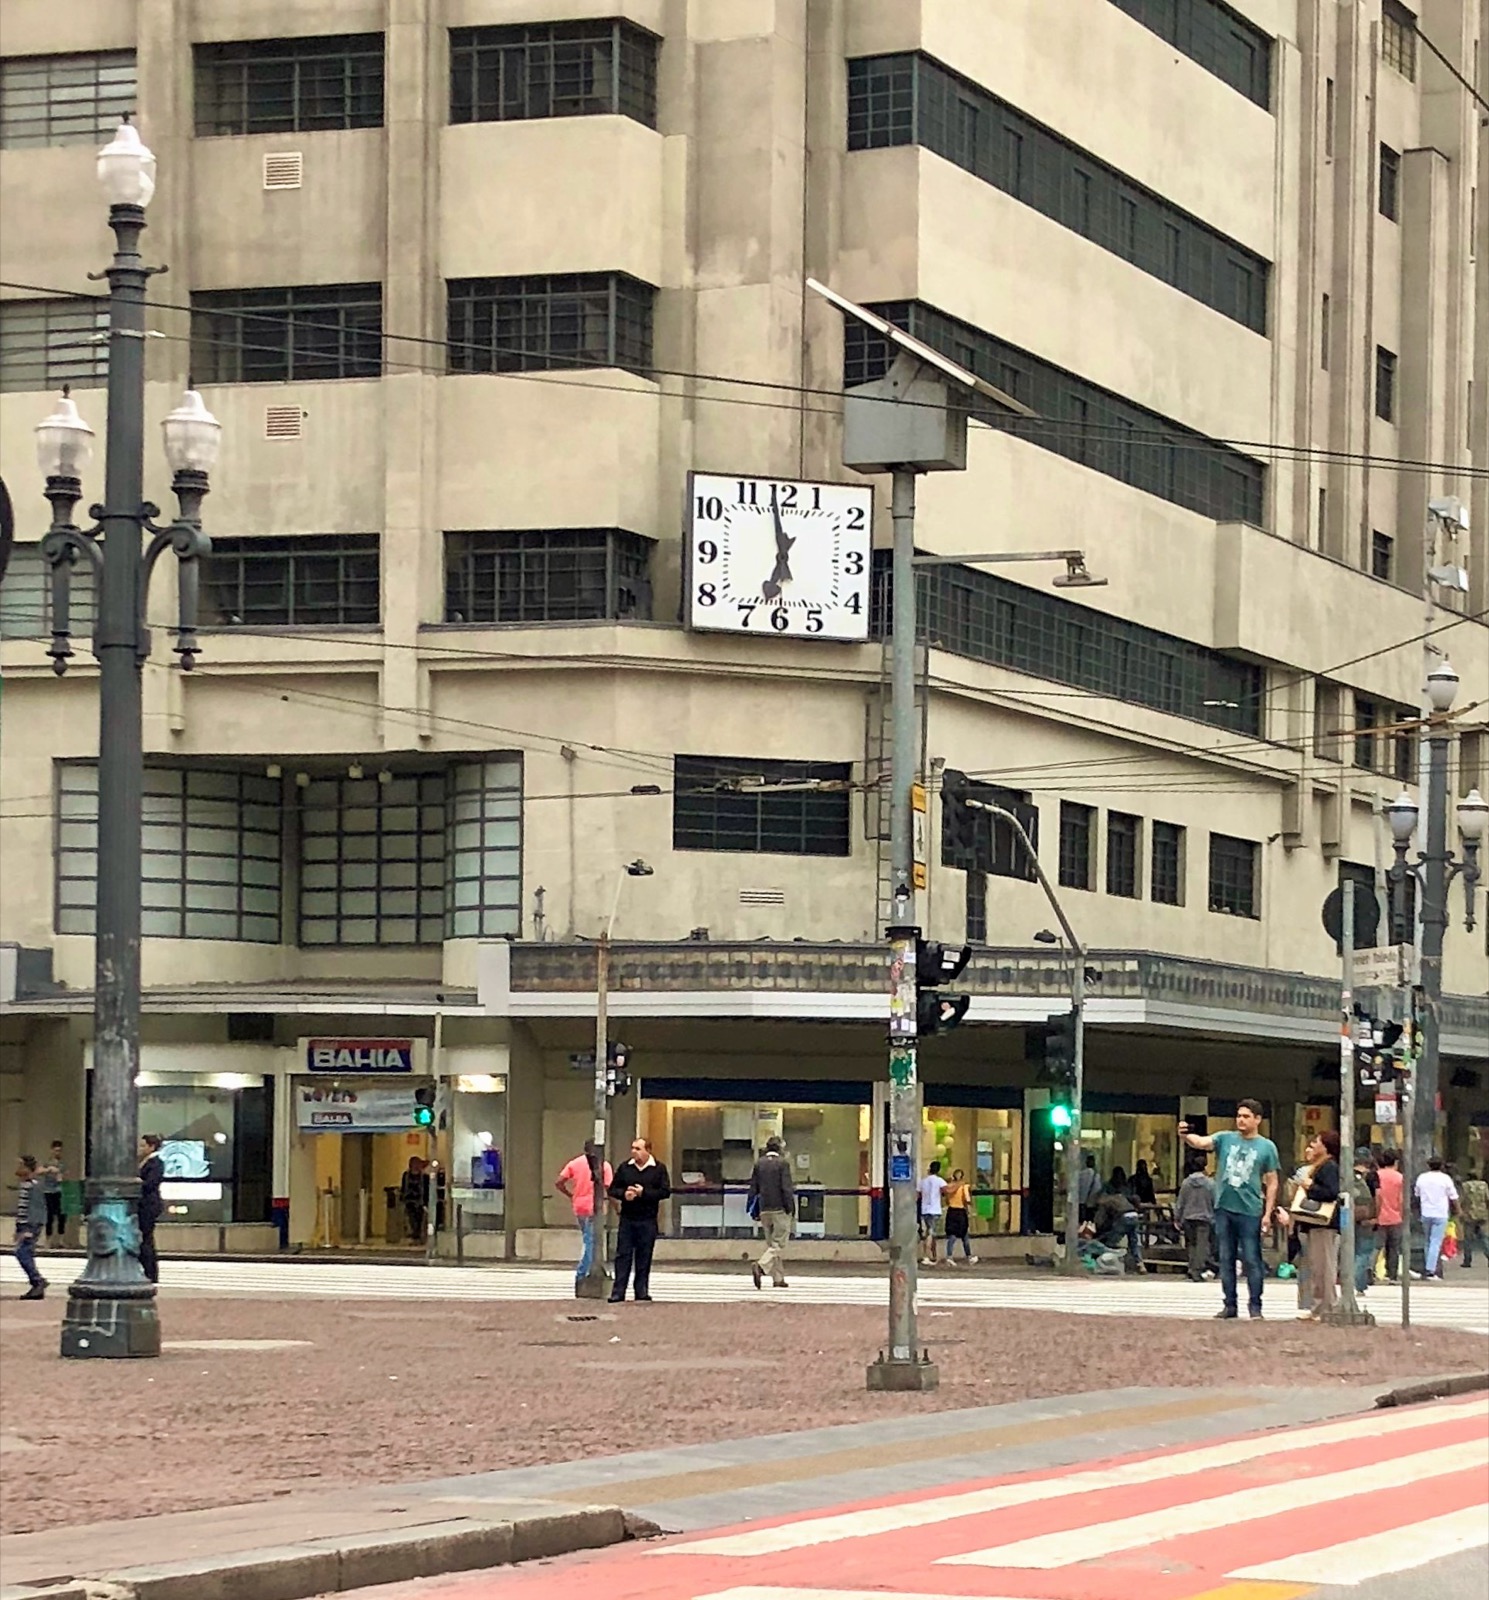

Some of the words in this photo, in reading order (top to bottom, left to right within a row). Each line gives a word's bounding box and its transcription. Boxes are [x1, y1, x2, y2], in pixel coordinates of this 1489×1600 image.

[737, 481, 757, 505] 11
[769, 484, 798, 508] 12
[812, 487, 821, 510] 1
[696, 496, 723, 521] 10
[846, 507, 865, 530] 2
[698, 540, 718, 564] 9
[844, 551, 864, 575] 3
[697, 583, 717, 606] 8
[843, 592, 863, 615] 4
[737, 605, 756, 627] 7
[771, 607, 789, 631] 6
[805, 610, 824, 632] 5
[313, 1048, 405, 1067] BAHIA
